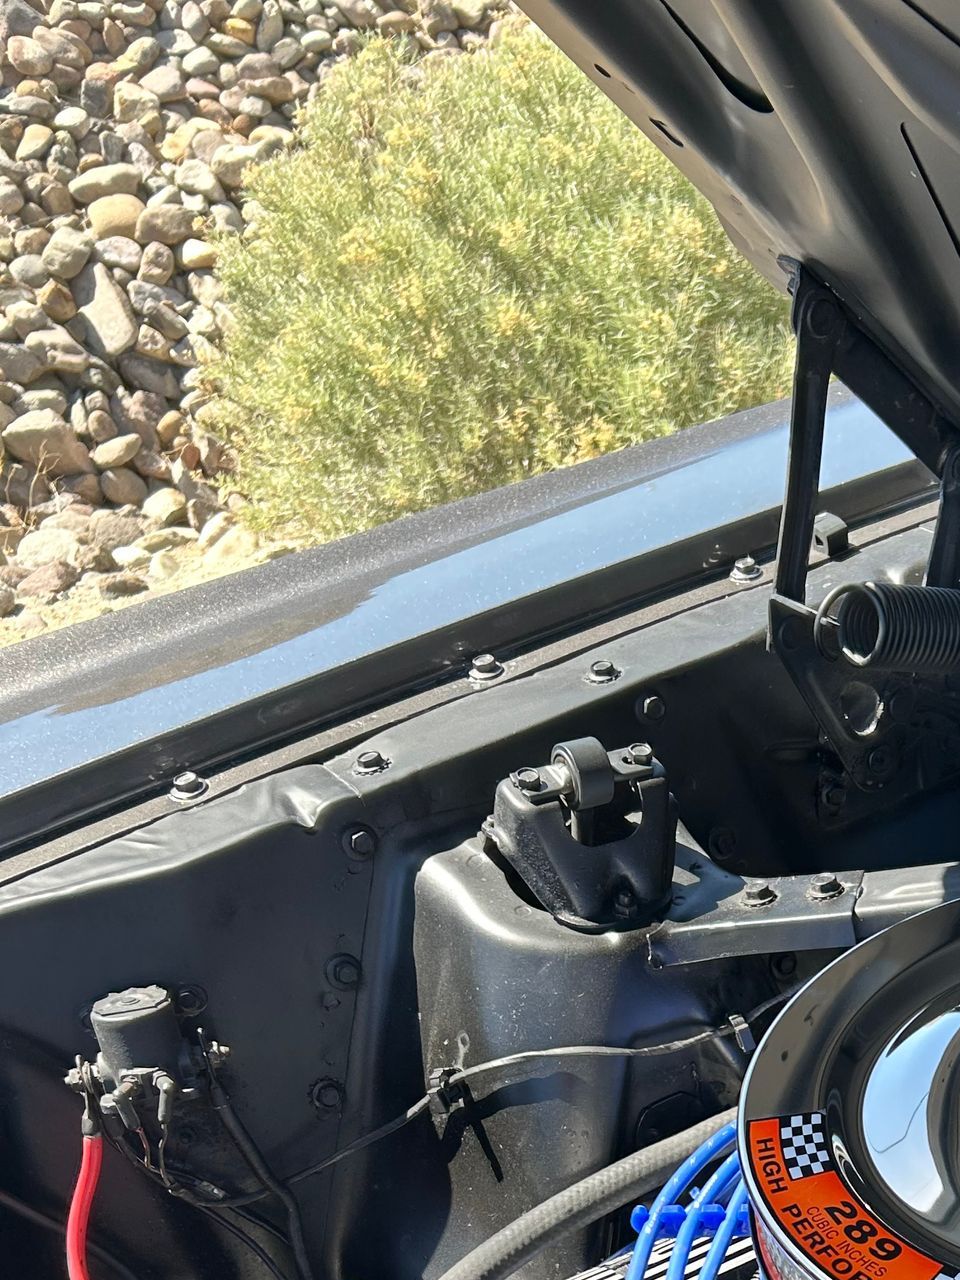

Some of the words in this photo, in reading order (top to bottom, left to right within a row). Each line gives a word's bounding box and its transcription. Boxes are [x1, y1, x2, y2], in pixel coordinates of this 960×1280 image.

[757, 1137, 789, 1194] HIGH
[806, 1205, 839, 1241] CUBIC
[835, 1240, 888, 1277] INCHES
[824, 1200, 902, 1262] 289
